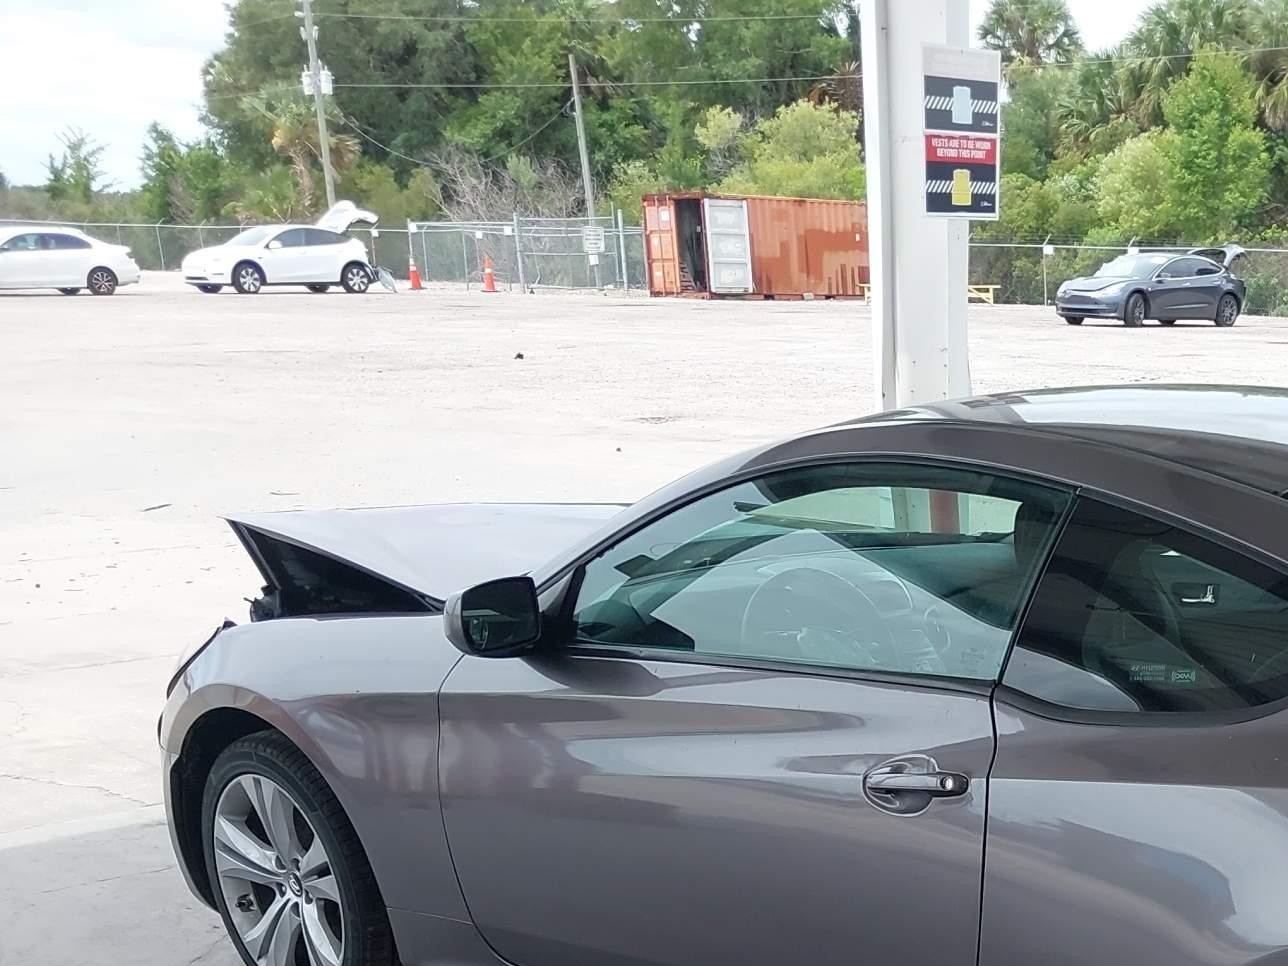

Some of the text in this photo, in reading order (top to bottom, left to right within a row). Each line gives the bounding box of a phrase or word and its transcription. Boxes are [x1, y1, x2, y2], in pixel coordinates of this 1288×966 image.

[931, 138, 948, 147] VESTS
[936, 147, 986, 159] BEYOND THIS POINT
